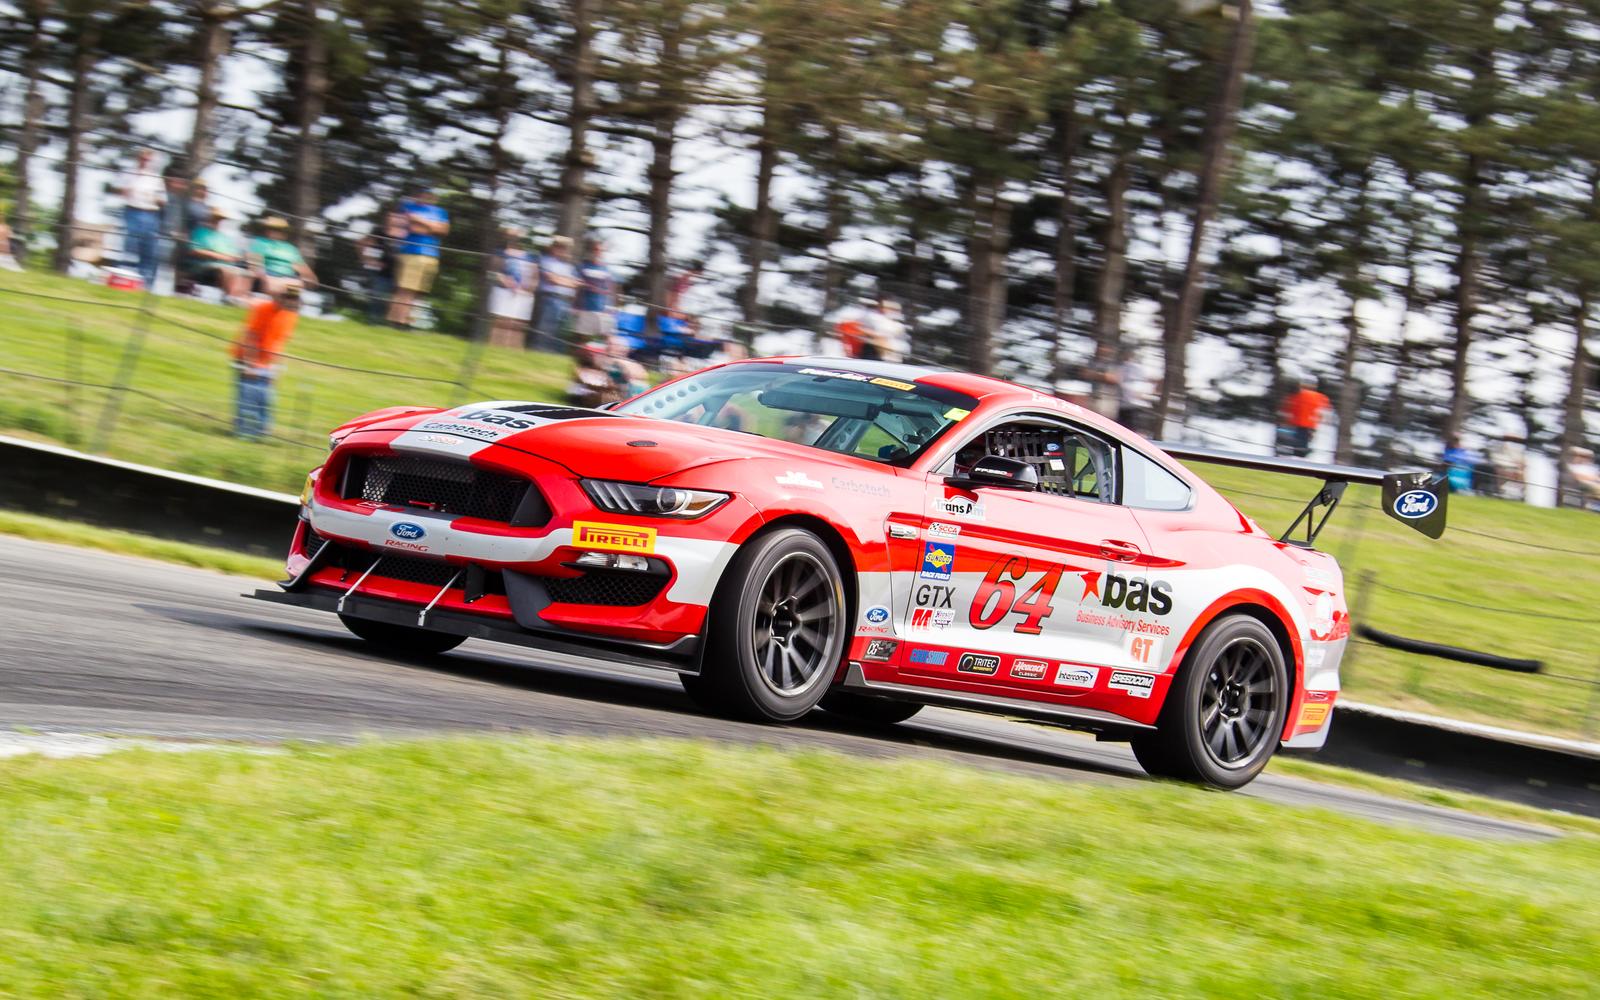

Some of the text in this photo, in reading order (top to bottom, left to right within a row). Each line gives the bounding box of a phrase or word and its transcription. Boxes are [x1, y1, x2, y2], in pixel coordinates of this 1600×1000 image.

[458, 410, 536, 429] bas
[423, 422, 498, 438] Carbotech
[935, 498, 964, 514] Trans
[1400, 493, 1431, 514] Ford
[395, 524, 419, 538] Ford
[579, 526, 649, 548] PIRELLI
[938, 525, 958, 534] SCCA
[385, 539, 430, 551] RACING
[926, 553, 952, 564] SUNOCO
[916, 584, 956, 608] GTX
[968, 550, 1067, 635] 64
[1101, 560, 1173, 616] bas
[869, 609, 886, 622] Ford
[1076, 610, 1170, 636] Business Advisory Services
[858, 625, 889, 633] RACING
[1131, 636, 1154, 663] GT
[973, 657, 997, 668] TRITEC
